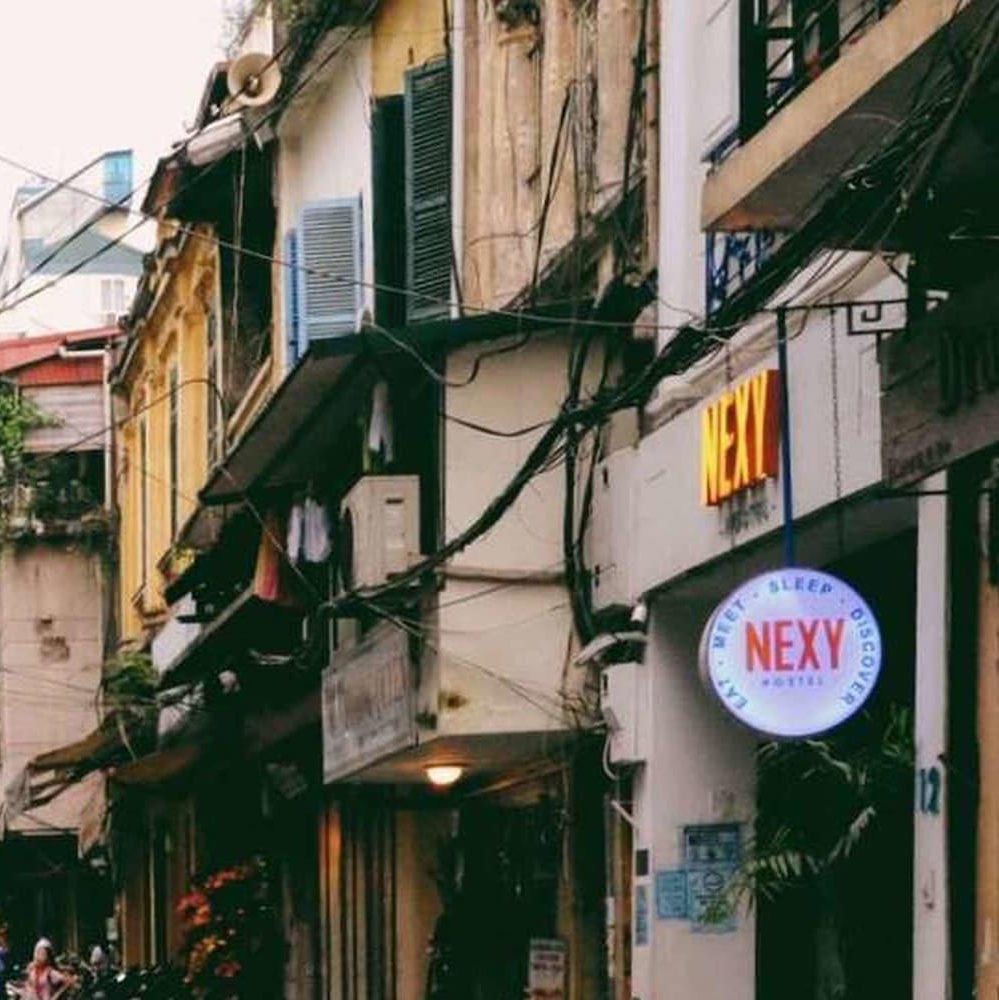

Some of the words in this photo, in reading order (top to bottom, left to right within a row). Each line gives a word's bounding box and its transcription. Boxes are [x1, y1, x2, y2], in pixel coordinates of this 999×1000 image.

[702, 368, 770, 506] NEXY
[769, 577, 833, 594] SLEEP
[713, 600, 746, 649] MEET
[745, 618, 845, 672] NEXY
[840, 608, 876, 706] DISCOVER
[718, 679, 748, 710] EAT
